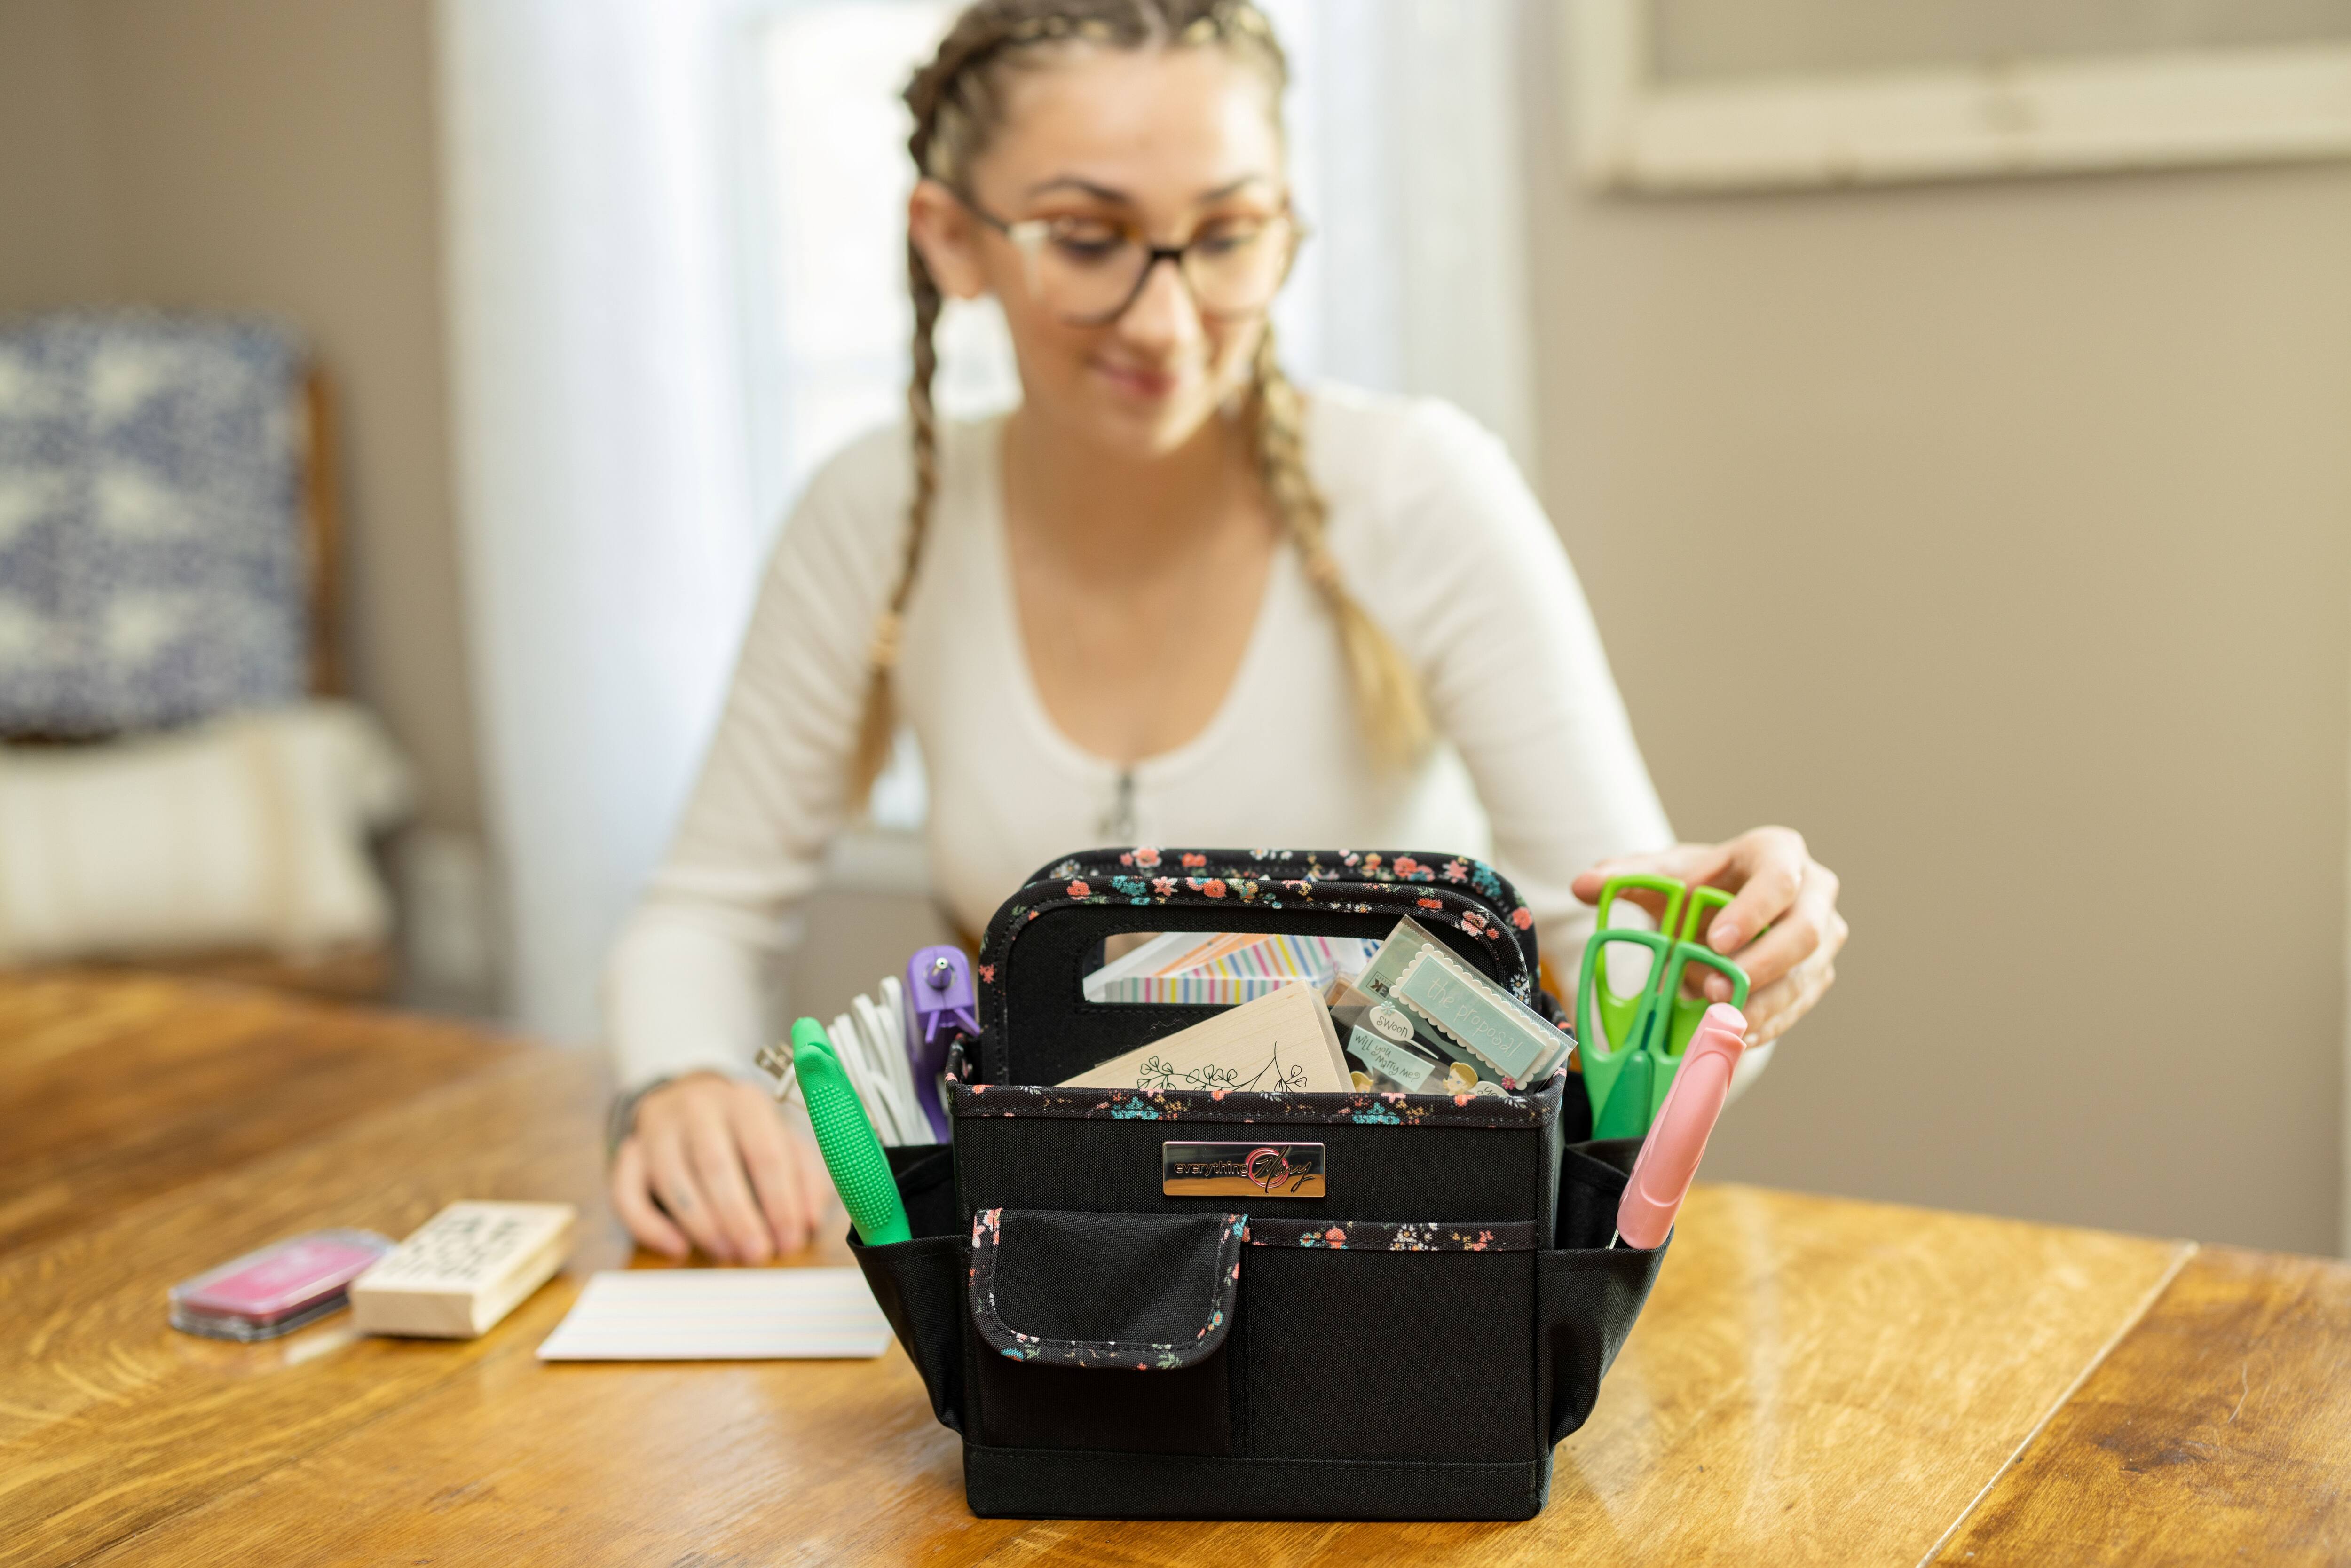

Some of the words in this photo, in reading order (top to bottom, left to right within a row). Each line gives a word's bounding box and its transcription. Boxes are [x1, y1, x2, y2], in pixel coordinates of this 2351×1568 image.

[1370, 978, 1389, 998] EK
[1427, 977, 1454, 1009] the
[1453, 1004, 1523, 1057] proposal
[1355, 1034, 1373, 1051] will
[1370, 1045, 1392, 1057] you
[1175, 1161, 1249, 1176] everything
[1254, 1144, 1316, 1194] Mary
